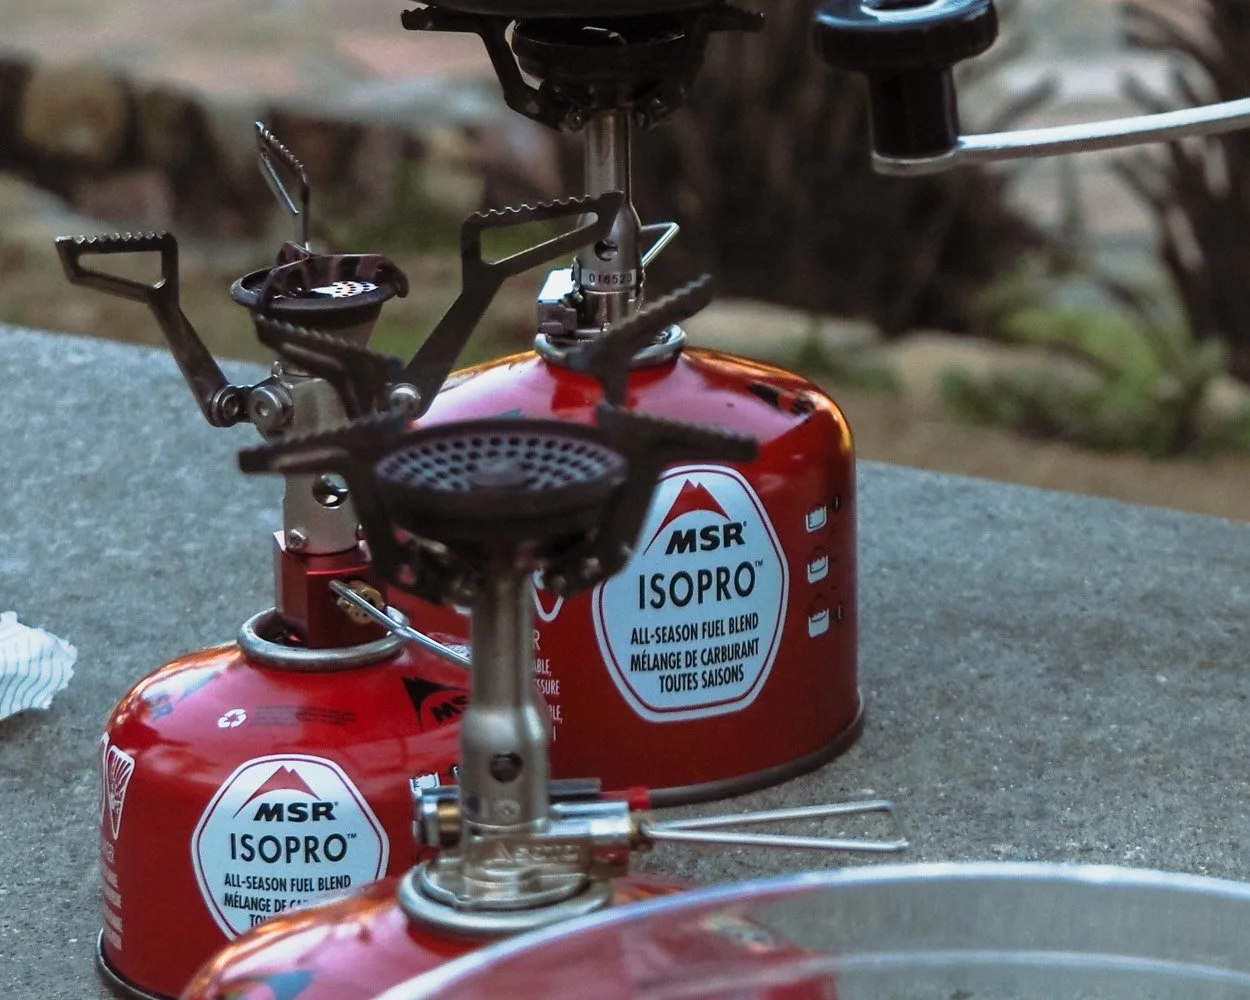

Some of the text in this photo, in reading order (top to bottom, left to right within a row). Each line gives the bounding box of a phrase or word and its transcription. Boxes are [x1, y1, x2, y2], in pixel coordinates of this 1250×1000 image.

[664, 521, 746, 555] MSR
[630, 612, 759, 645] ALL-SEASON FUEL BLEND
[630, 638, 760, 672] MÉLANGE DE CARBURANT
[658, 663, 745, 693] TOUTES SAISONS
[253, 801, 337, 822] MSR
[224, 873, 351, 892] ALL-SEASON FUEL BLEND
[223, 891, 272, 913] MÉLANGE
